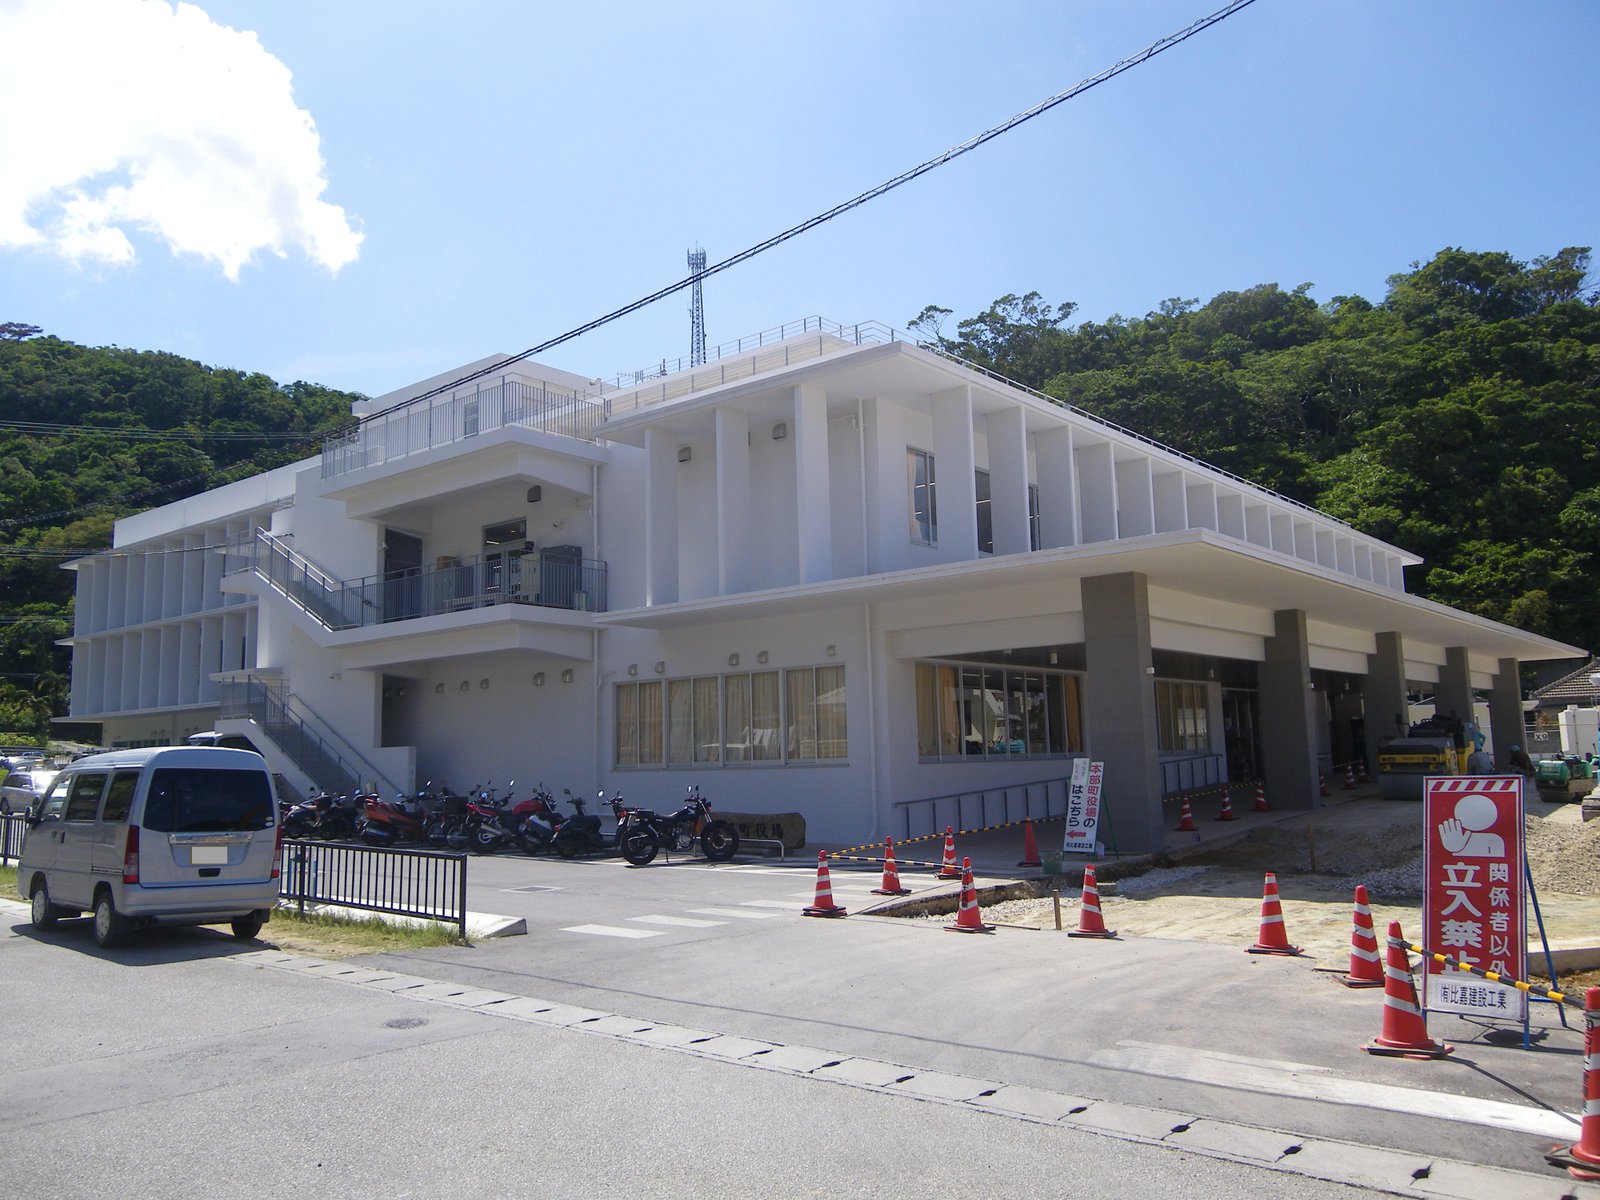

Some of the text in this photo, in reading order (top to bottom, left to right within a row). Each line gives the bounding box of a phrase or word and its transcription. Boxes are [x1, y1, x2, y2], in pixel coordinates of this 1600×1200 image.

[1069, 784, 1083, 828] はこちら
[1083, 764, 1102, 828] 本部町役場の
[1440, 861, 1483, 978] 立入禁止
[1488, 862, 1511, 978] 関係者以外
